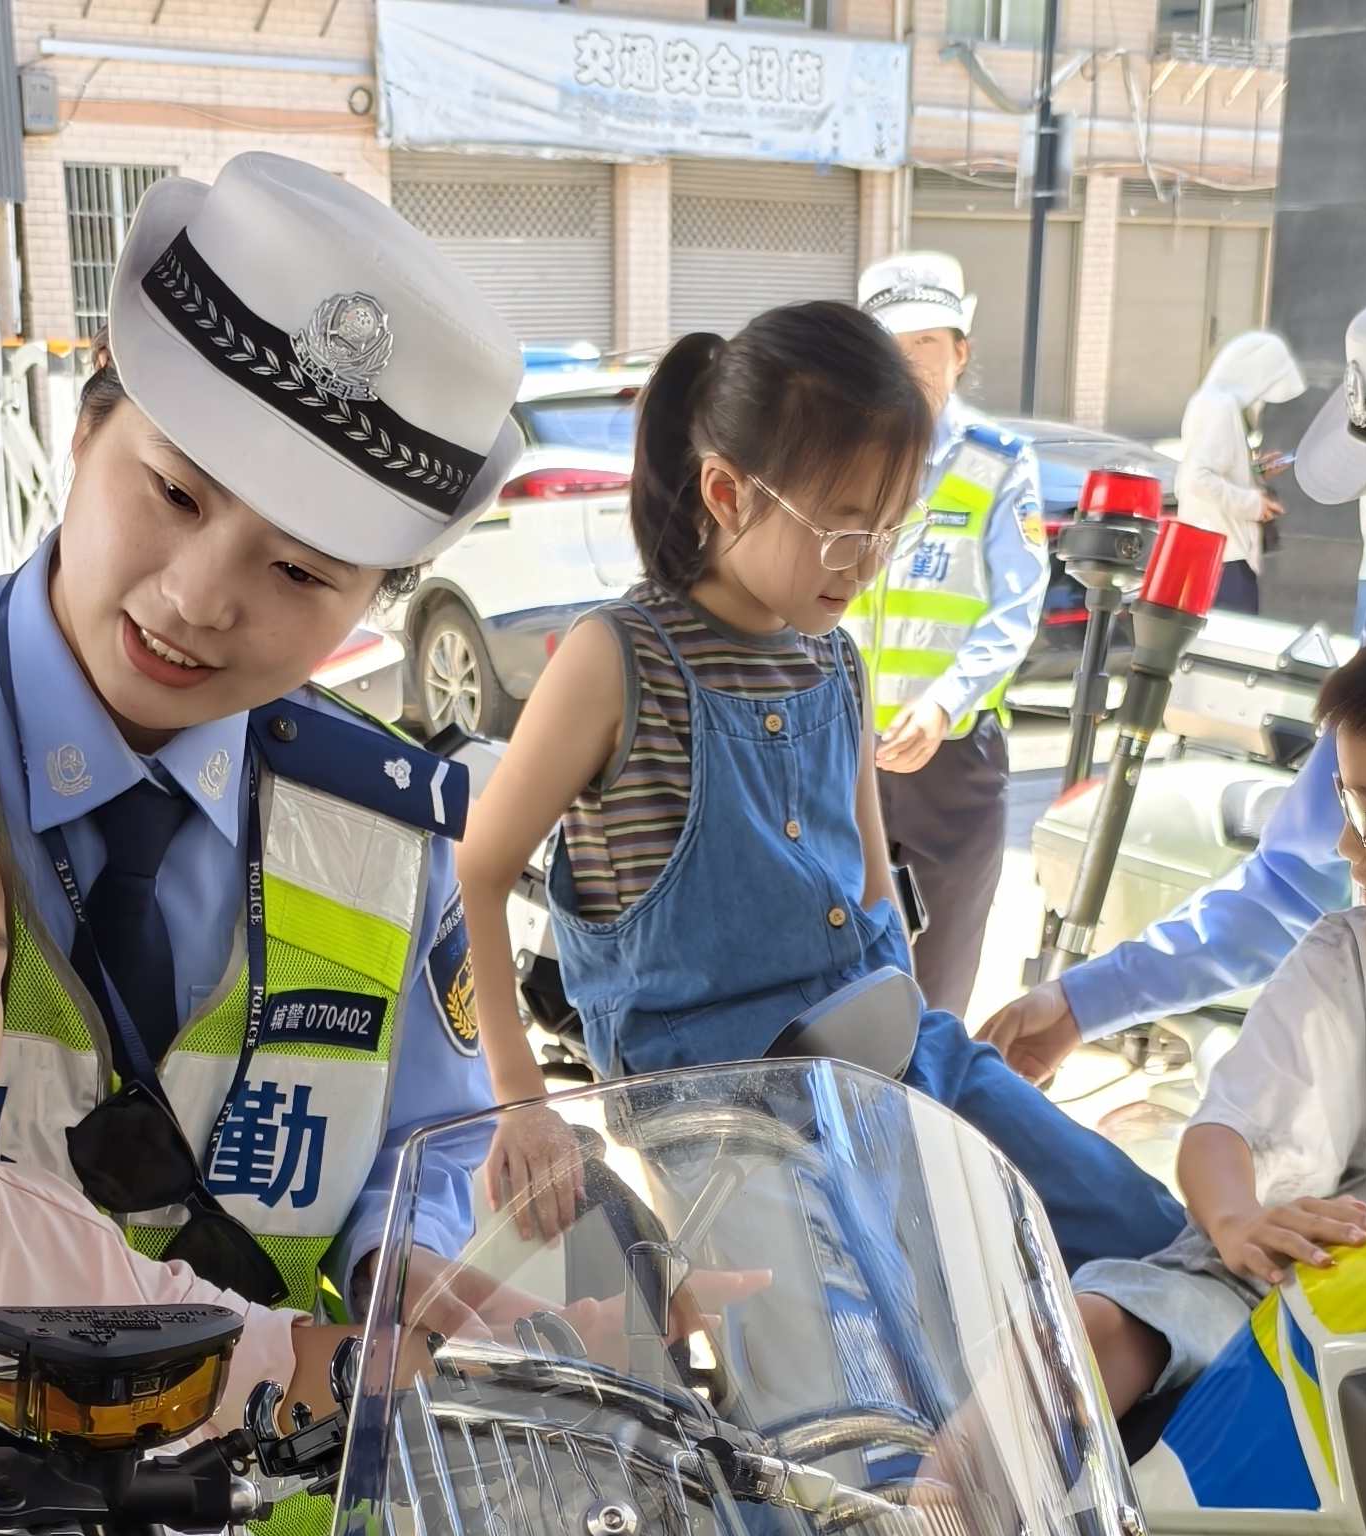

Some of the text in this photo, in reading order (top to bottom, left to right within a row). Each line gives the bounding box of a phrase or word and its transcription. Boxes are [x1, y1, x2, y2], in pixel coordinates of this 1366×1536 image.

[573, 30, 823, 104] 交通安全设施
[249, 861, 262, 926] POLICE
[246, 985, 264, 1049] POLICE
[205, 1080, 327, 1208] 勤
